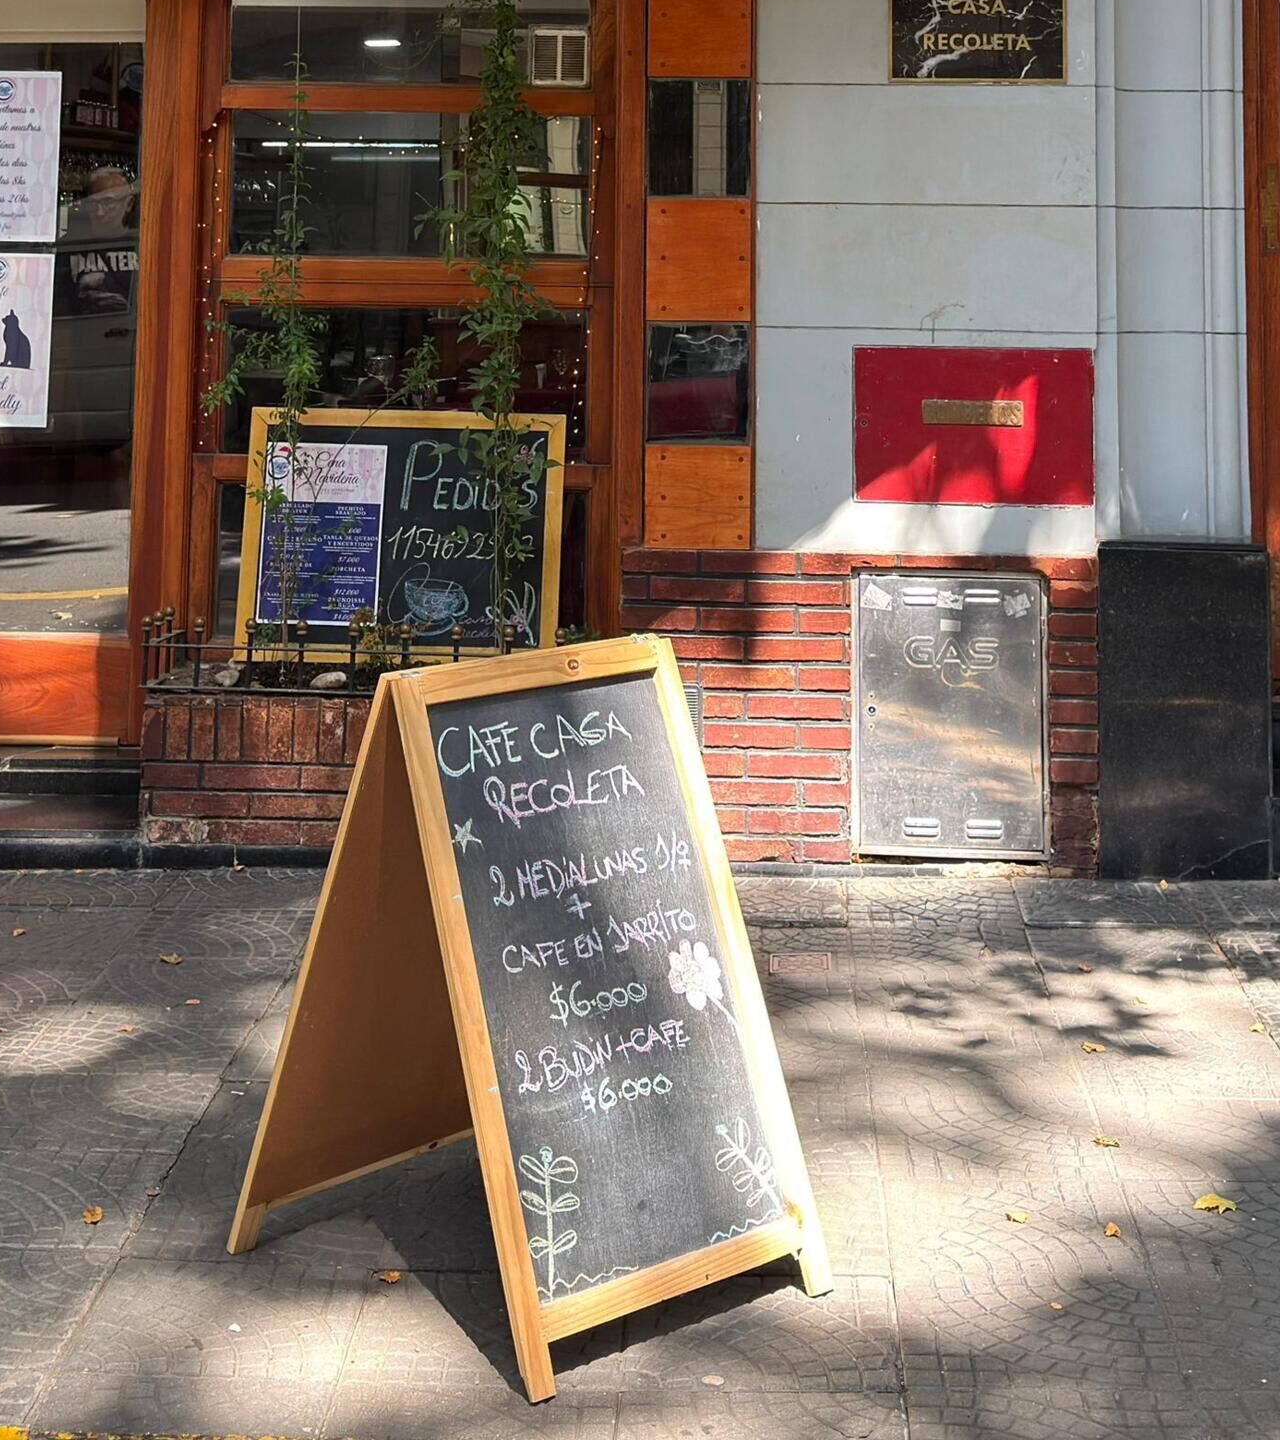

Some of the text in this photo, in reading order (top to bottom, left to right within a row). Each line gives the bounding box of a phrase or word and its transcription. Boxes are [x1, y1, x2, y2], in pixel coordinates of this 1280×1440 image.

[923, 33, 1032, 51] RECOLETA
[314, 451, 346, 469] Cena
[903, 635, 1001, 669] GAS
[437, 711, 633, 777] CAFE CASA
[482, 764, 646, 828] RECOLETA
[489, 865, 515, 907] 2
[502, 939, 569, 974] CAFE
[573, 928, 604, 959] EN
[549, 980, 648, 1028] $6.000
[580, 1072, 673, 1113] $6.000
